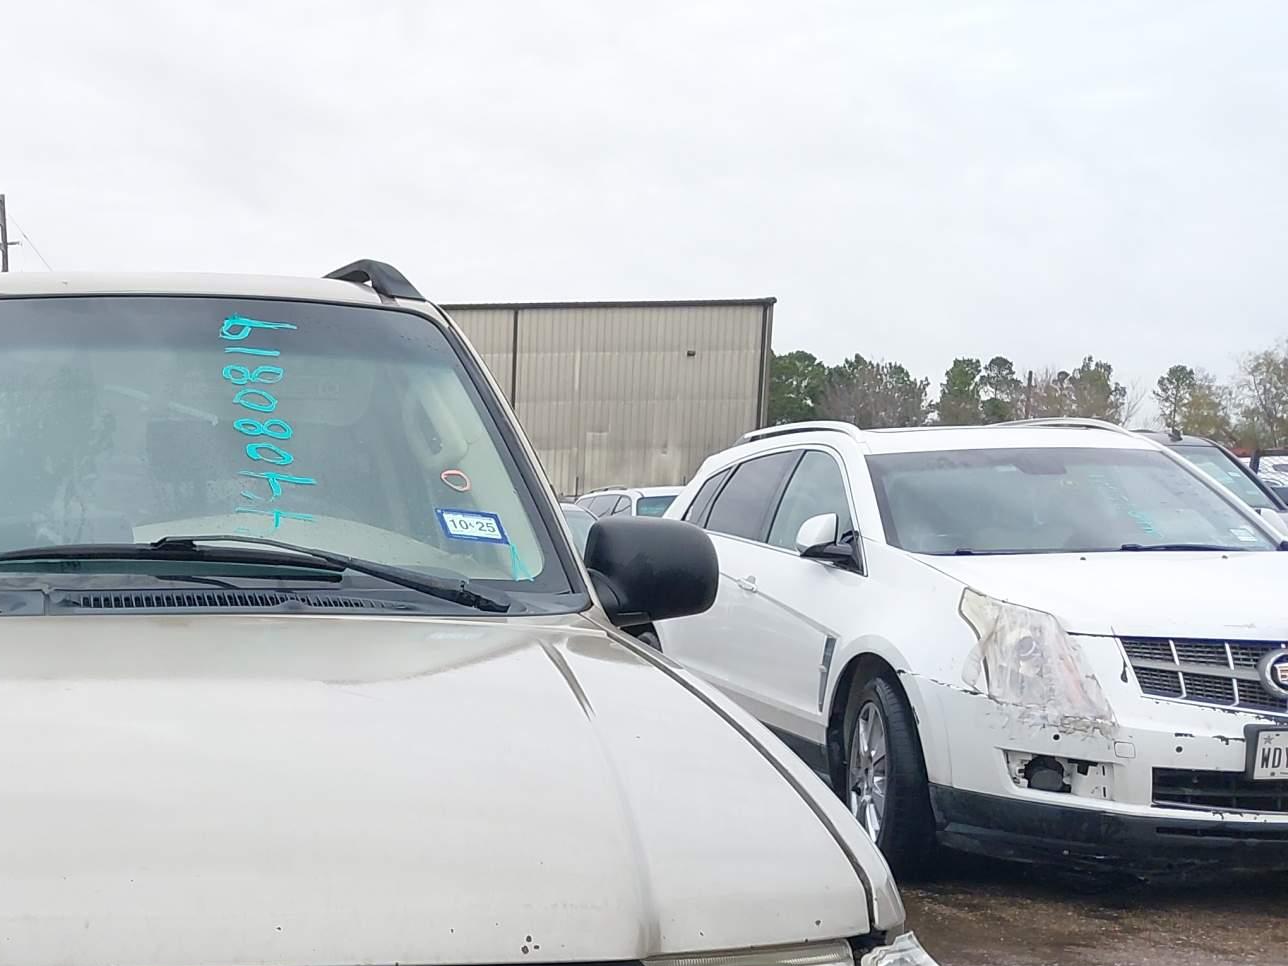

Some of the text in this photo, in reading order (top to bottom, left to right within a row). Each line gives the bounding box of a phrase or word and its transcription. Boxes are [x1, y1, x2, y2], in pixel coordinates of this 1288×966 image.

[449, 519, 496, 533] 10 25
[1260, 747, 1288, 769] WD
